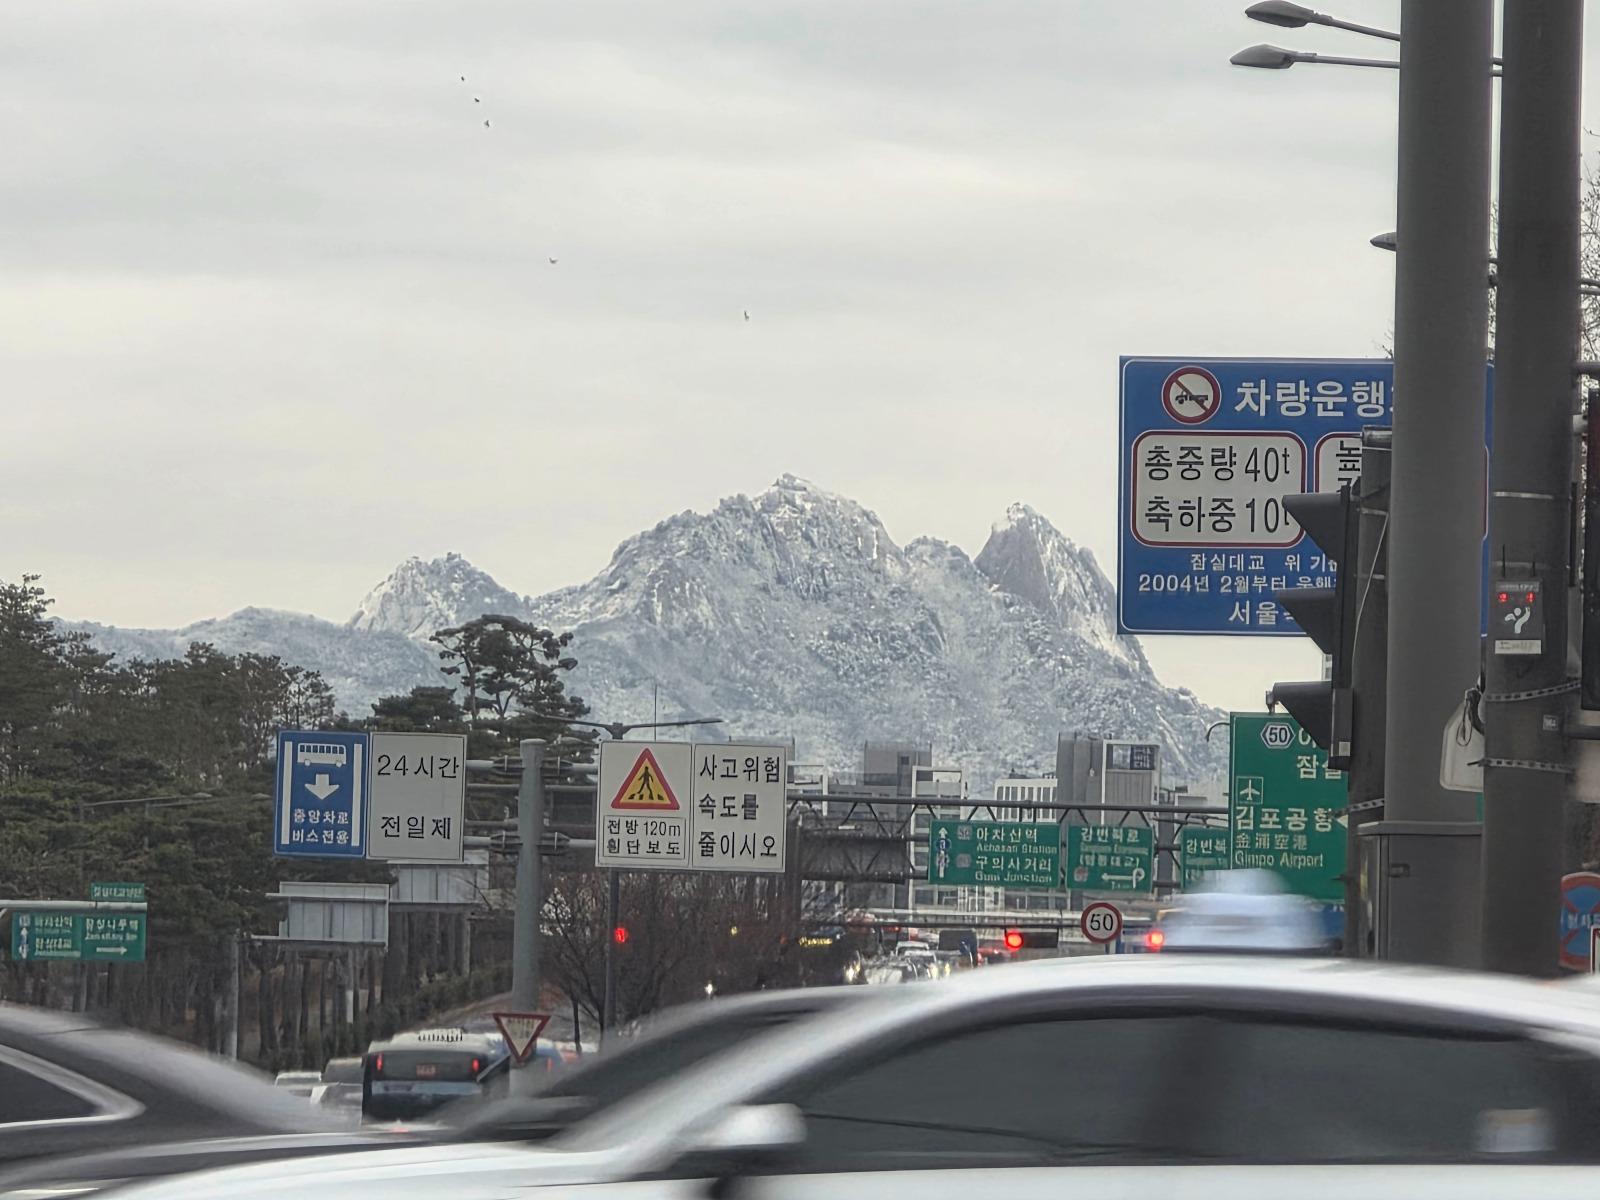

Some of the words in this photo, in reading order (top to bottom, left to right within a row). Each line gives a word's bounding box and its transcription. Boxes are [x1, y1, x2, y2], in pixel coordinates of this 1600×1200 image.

[1234, 379, 1393, 418] 차량운행
[1144, 445, 1237, 481] 총중량
[1244, 447, 1290, 482] 40t
[1144, 496, 1236, 532] 축하중
[1190, 553, 1265, 572] 잠실대교
[1285, 553, 1300, 572] 위
[1138, 574, 1210, 593] 2004년
[1220, 574, 1286, 594] 2월부터
[1228, 600, 1294, 625] 서울
[1268, 727, 1288, 743] 50
[699, 754, 780, 783] 사고위험
[698, 793, 759, 820] 속도를
[293, 808, 349, 825] 중앙차로
[1235, 806, 1332, 832] 김포공항
[292, 829, 349, 844] 버스전용
[380, 815, 452, 840] 전일제
[607, 819, 638, 835] 전방
[643, 820, 681, 837] 120m
[976, 827, 1037, 843] 아차산역
[607, 838, 681, 855] 횡단보도
[698, 831, 777, 859] 줄이시오
[976, 855, 1051, 872] 구의사거리
[1235, 850, 1275, 868] Gimpo
[1280, 852, 1323, 869] Airport
[1090, 913, 1114, 931] 50
